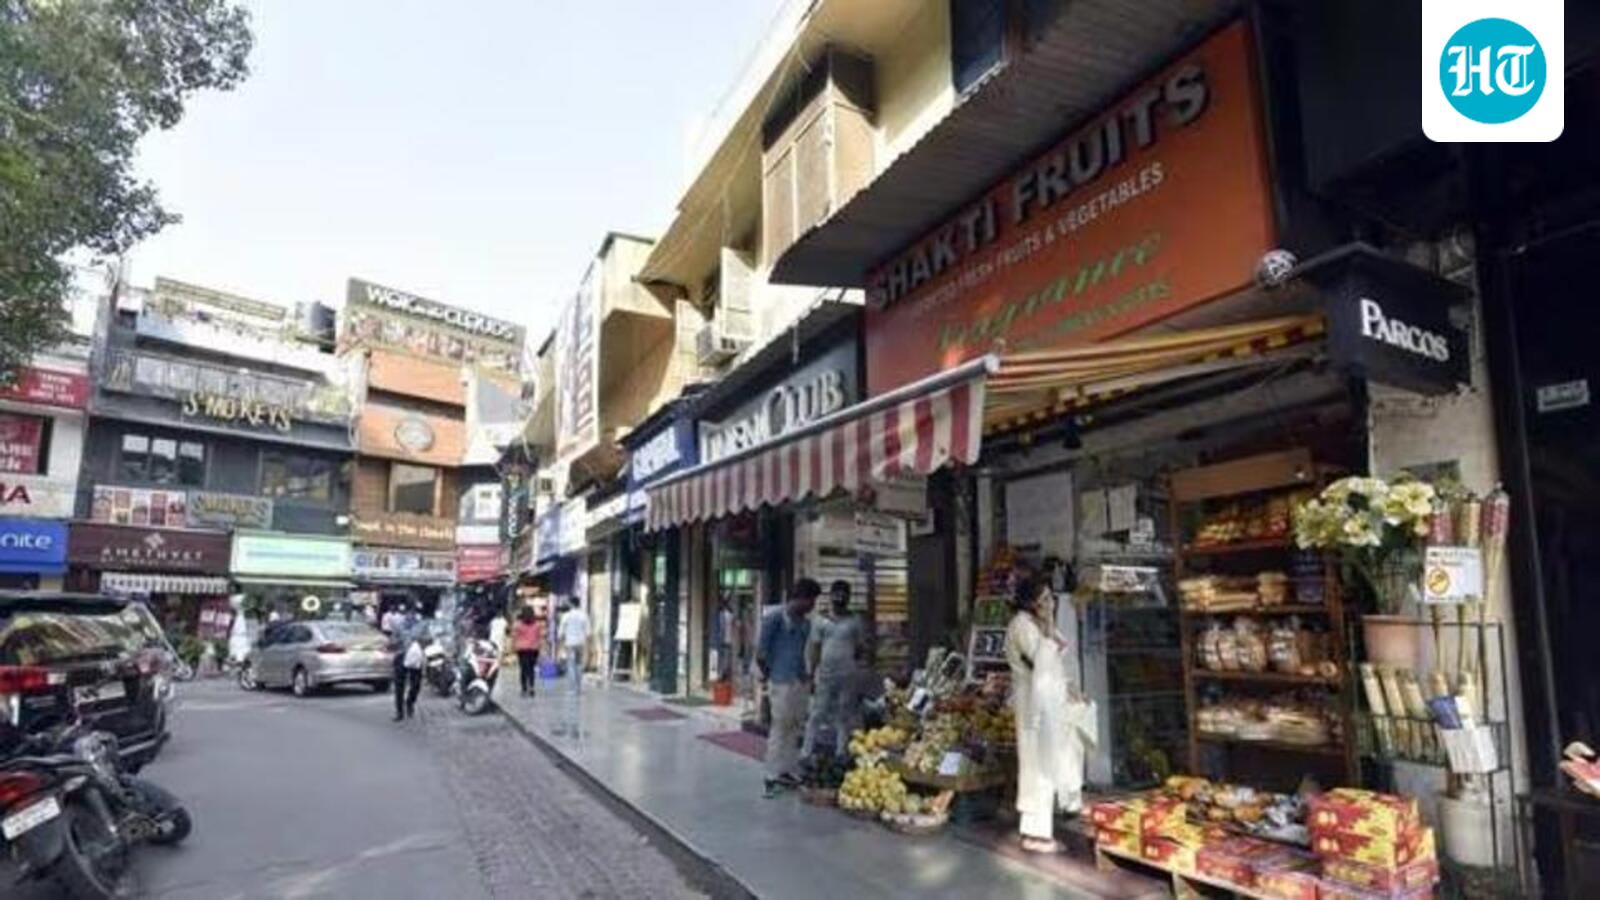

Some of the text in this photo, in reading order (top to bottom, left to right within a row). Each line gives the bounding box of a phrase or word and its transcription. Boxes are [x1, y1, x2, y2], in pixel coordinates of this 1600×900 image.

[867, 63, 1208, 311] SHAKTI FRUITS
[998, 229, 1042, 267] FRUITS
[1056, 161, 1165, 237] VEGETABLES
[1360, 298, 1450, 362] PARCOS
[759, 369, 846, 440] CLUB
[102, 548, 203, 561] AMETHYST
